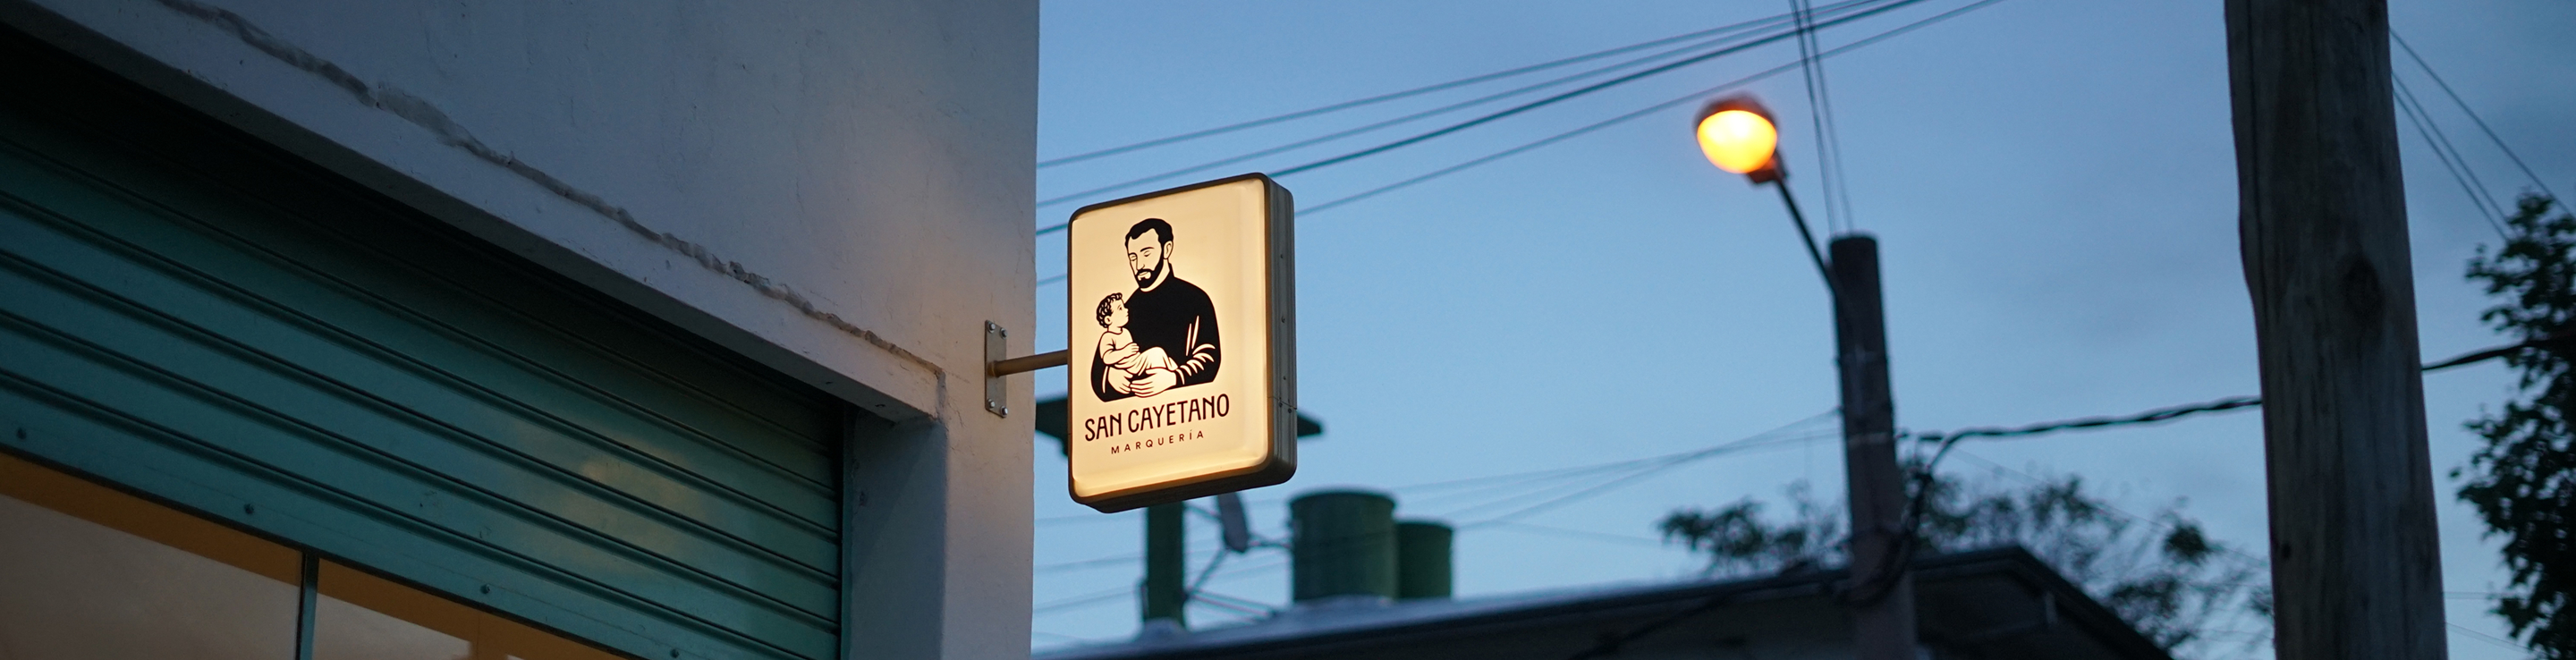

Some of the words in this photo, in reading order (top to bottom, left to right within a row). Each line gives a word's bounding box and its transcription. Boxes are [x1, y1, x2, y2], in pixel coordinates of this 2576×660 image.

[1085, 412, 1123, 442] SAN
[1128, 393, 1230, 433] CAYETANO
[1111, 429, 1204, 454] MARQUERÍA
